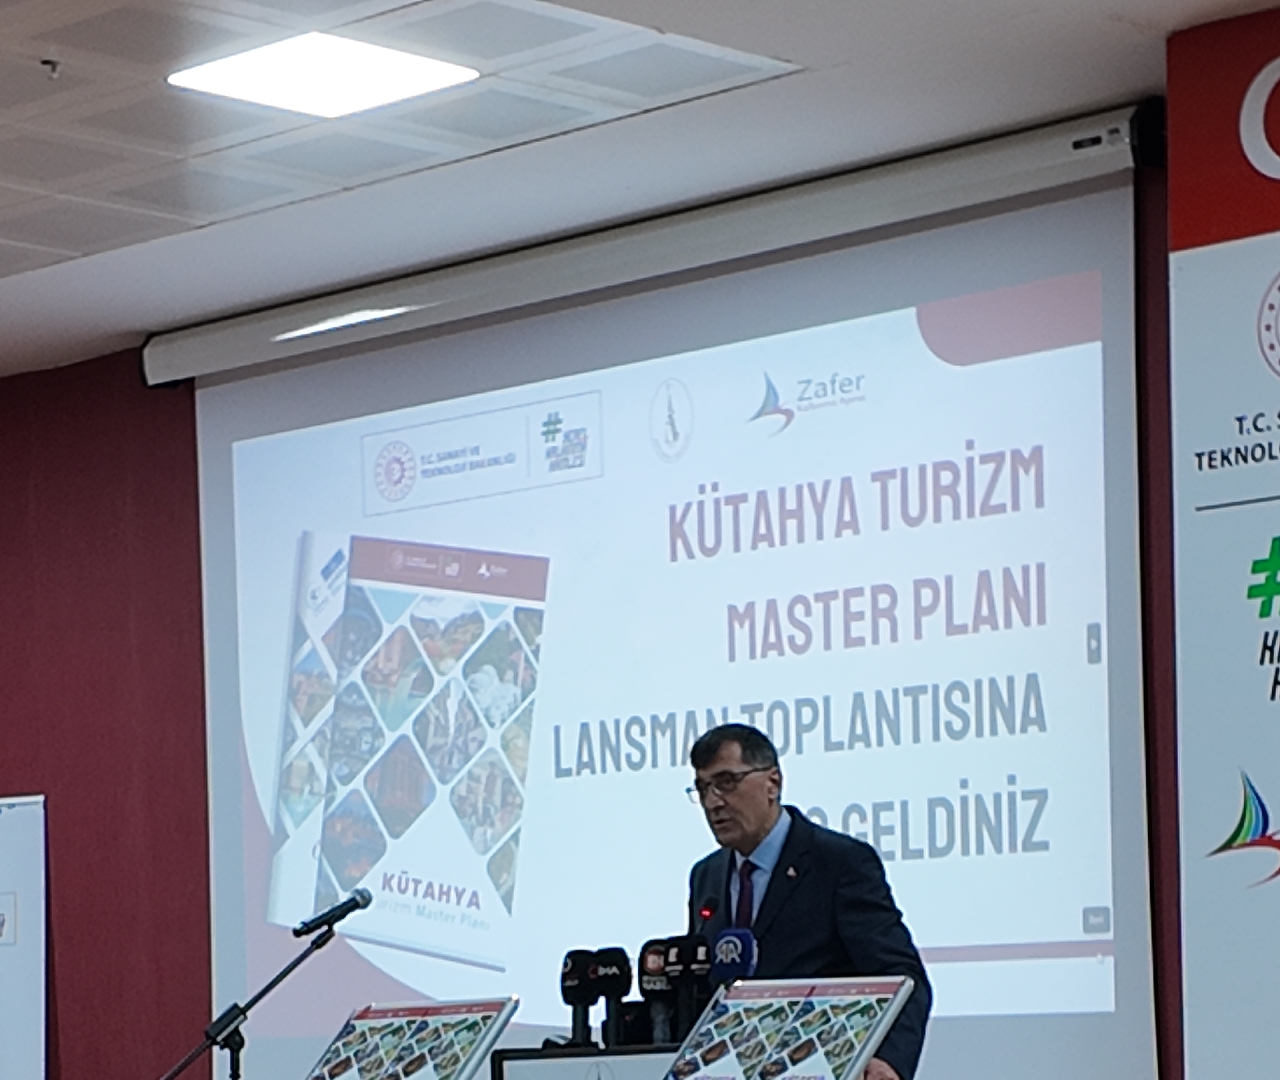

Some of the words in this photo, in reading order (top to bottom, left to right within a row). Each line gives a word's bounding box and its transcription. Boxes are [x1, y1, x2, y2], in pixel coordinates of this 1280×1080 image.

[797, 372, 866, 402] Zafer
[1234, 412, 1271, 436] T.C.
[669, 475, 861, 562] KÜTAHYA
[870, 439, 1045, 532] TURİZM
[727, 583, 899, 663] MASTER
[913, 562, 1047, 640] PLANI
[841, 774, 1050, 862] GELDİNİZ
[381, 870, 482, 911] KÜTAHYA
